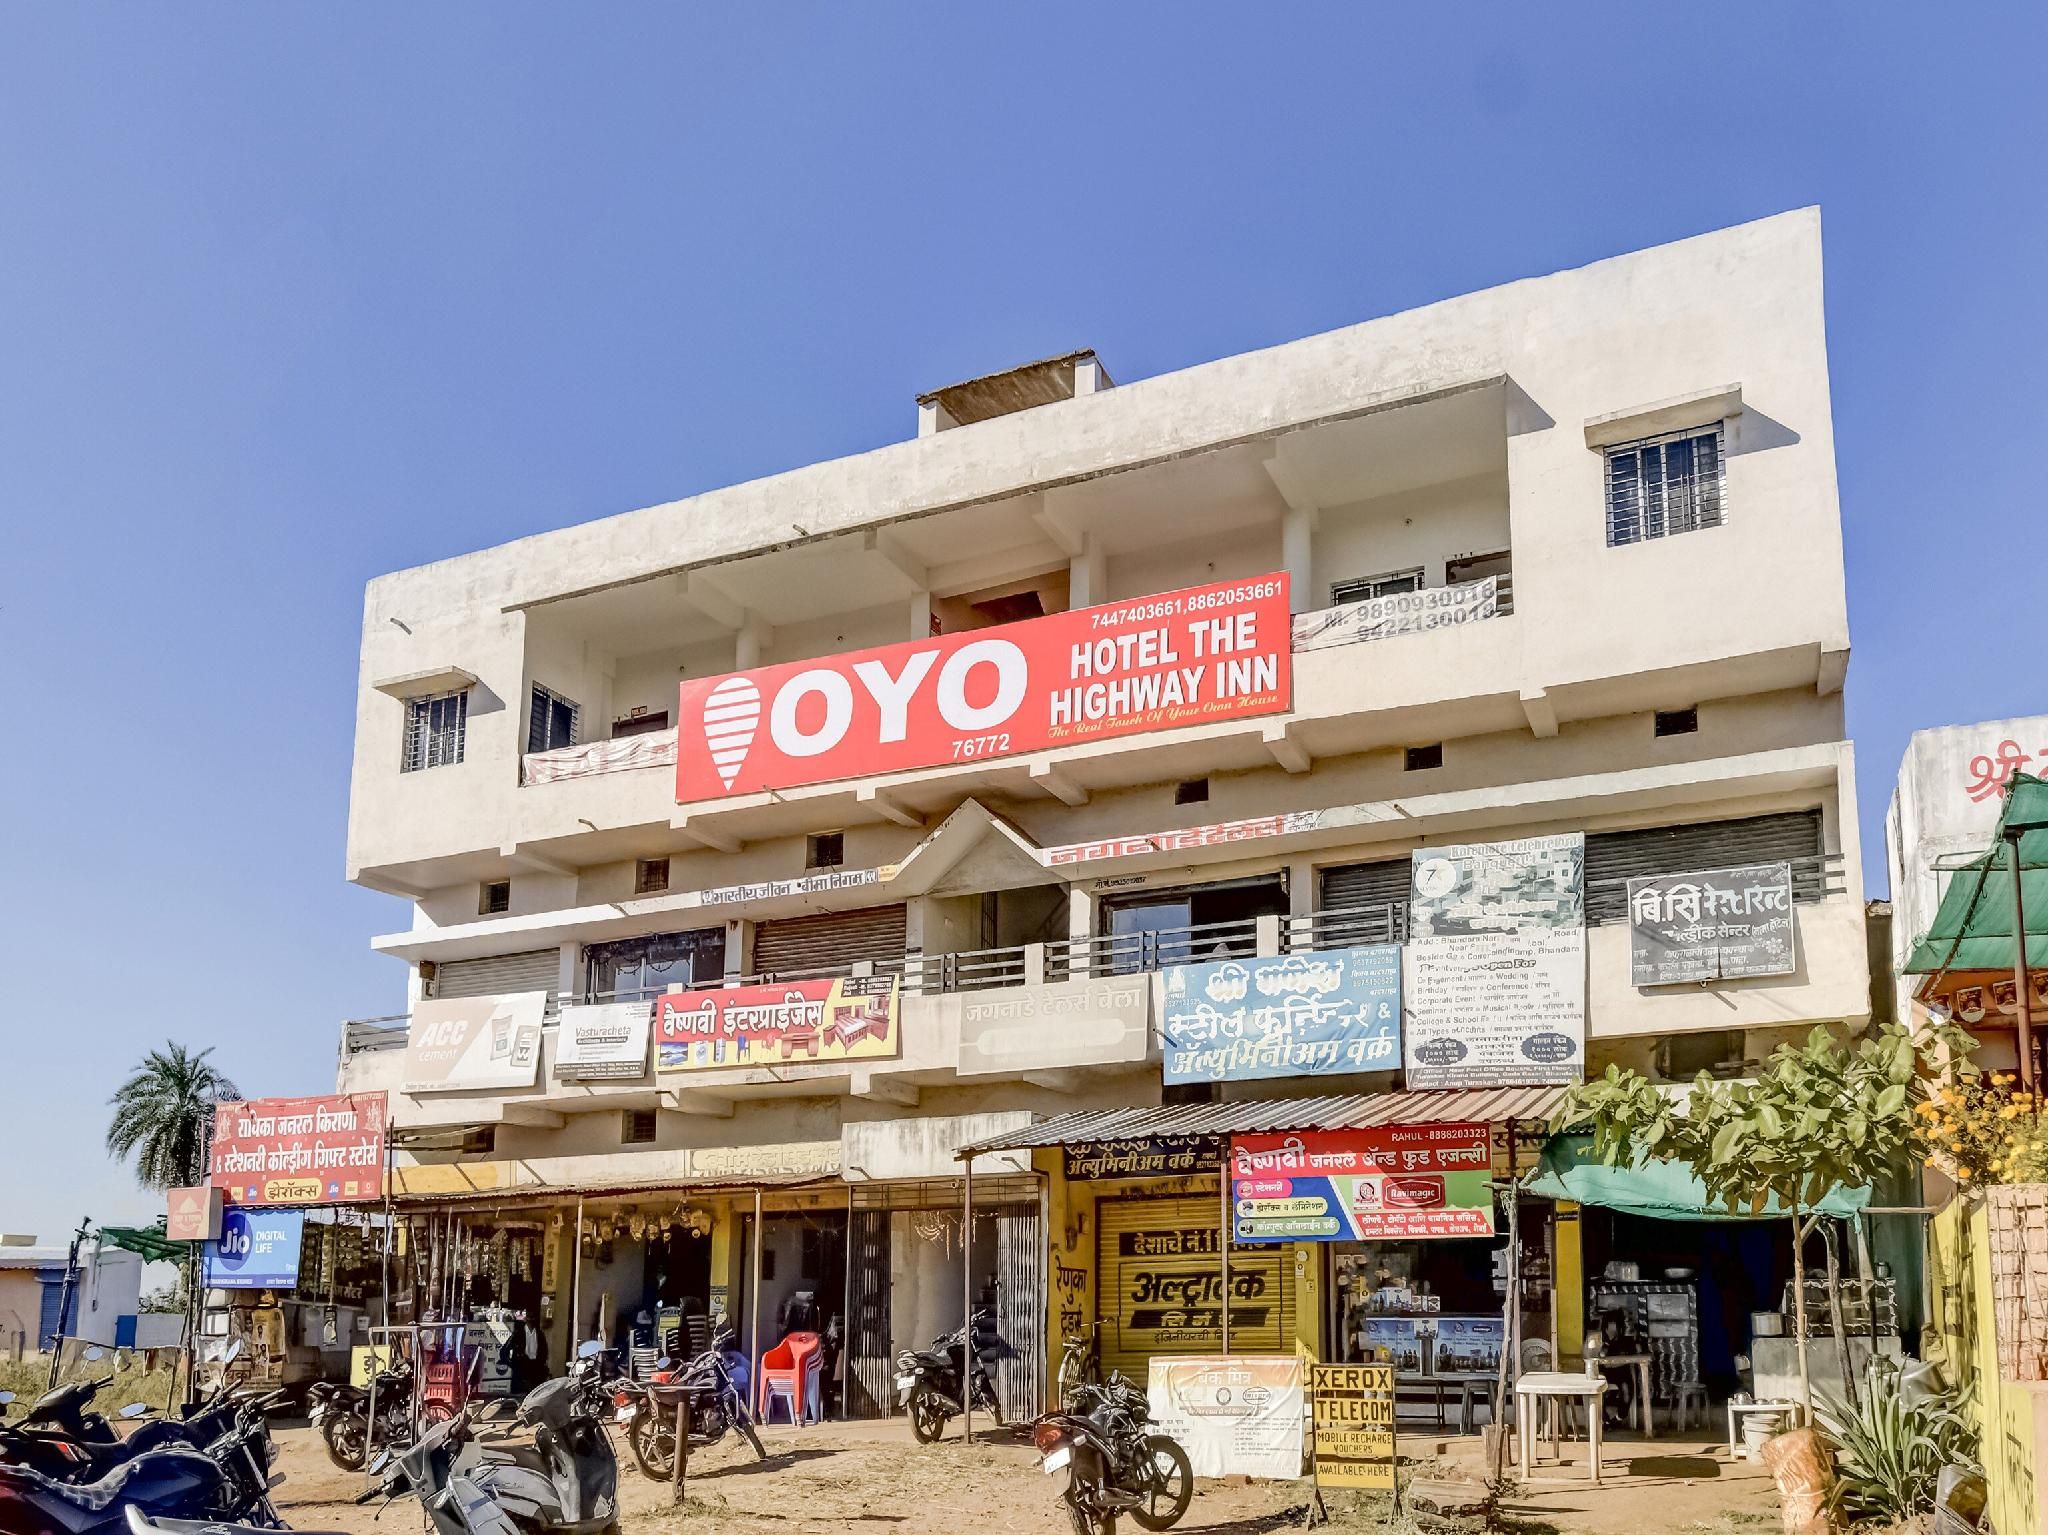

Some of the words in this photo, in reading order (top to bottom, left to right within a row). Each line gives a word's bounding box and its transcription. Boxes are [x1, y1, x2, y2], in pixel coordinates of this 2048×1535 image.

[1092, 580, 1282, 629] 7447403661,8862053661
[1071, 628, 1179, 680] HOTEL
[1189, 612, 1257, 657] THE
[769, 638, 1028, 758] OYO
[1050, 666, 1206, 726] HIGHWAY
[1217, 654, 1279, 699] INN
[1048, 727, 1070, 738] The
[1073, 721, 1103, 735] Real
[1106, 717, 1142, 729] Touch
[1147, 711, 1162, 723] Of
[1166, 708, 1200, 721] Your
[1203, 702, 1232, 713] Own
[1236, 695, 1278, 708] House
[952, 733, 1011, 759] 76772
[663, 998, 718, 1037] वैष्णवी
[1379, 1002, 1391, 1019] &
[415, 1020, 469, 1048] ACC
[418, 1048, 457, 1062] cement
[1348, 1026, 1396, 1065] वर्क
[278, 1114, 314, 1136] जनरल
[1391, 1132, 1423, 1142] RAHUL
[224, 1143, 266, 1173] स्टेशनरी
[314, 1140, 346, 1168] गिफ्ट
[348, 1136, 379, 1166] स्टोर्स
[1169, 1147, 1196, 1169] वर्क
[1235, 1136, 1306, 1175] वैष्णवी
[1401, 1149, 1431, 1171] फुड
[1436, 1141, 1487, 1168] एजन्सी
[267, 1181, 319, 1200] झेरॉक्स
[220, 1227, 250, 1254] Jio
[256, 1231, 287, 1241] DIGITAL
[256, 1243, 272, 1253] LIFE
[1316, 1370, 1389, 1388] XEROX
[1316, 1400, 1391, 1421] TELECOM
[1318, 1432, 1347, 1443] MOBILE
[1351, 1433, 1391, 1444] RECHARGE
[1334, 1444, 1372, 1453] VOUCHERS
[1318, 1464, 1364, 1476] AVAILABLE
[1368, 1465, 1389, 1476] HERE
